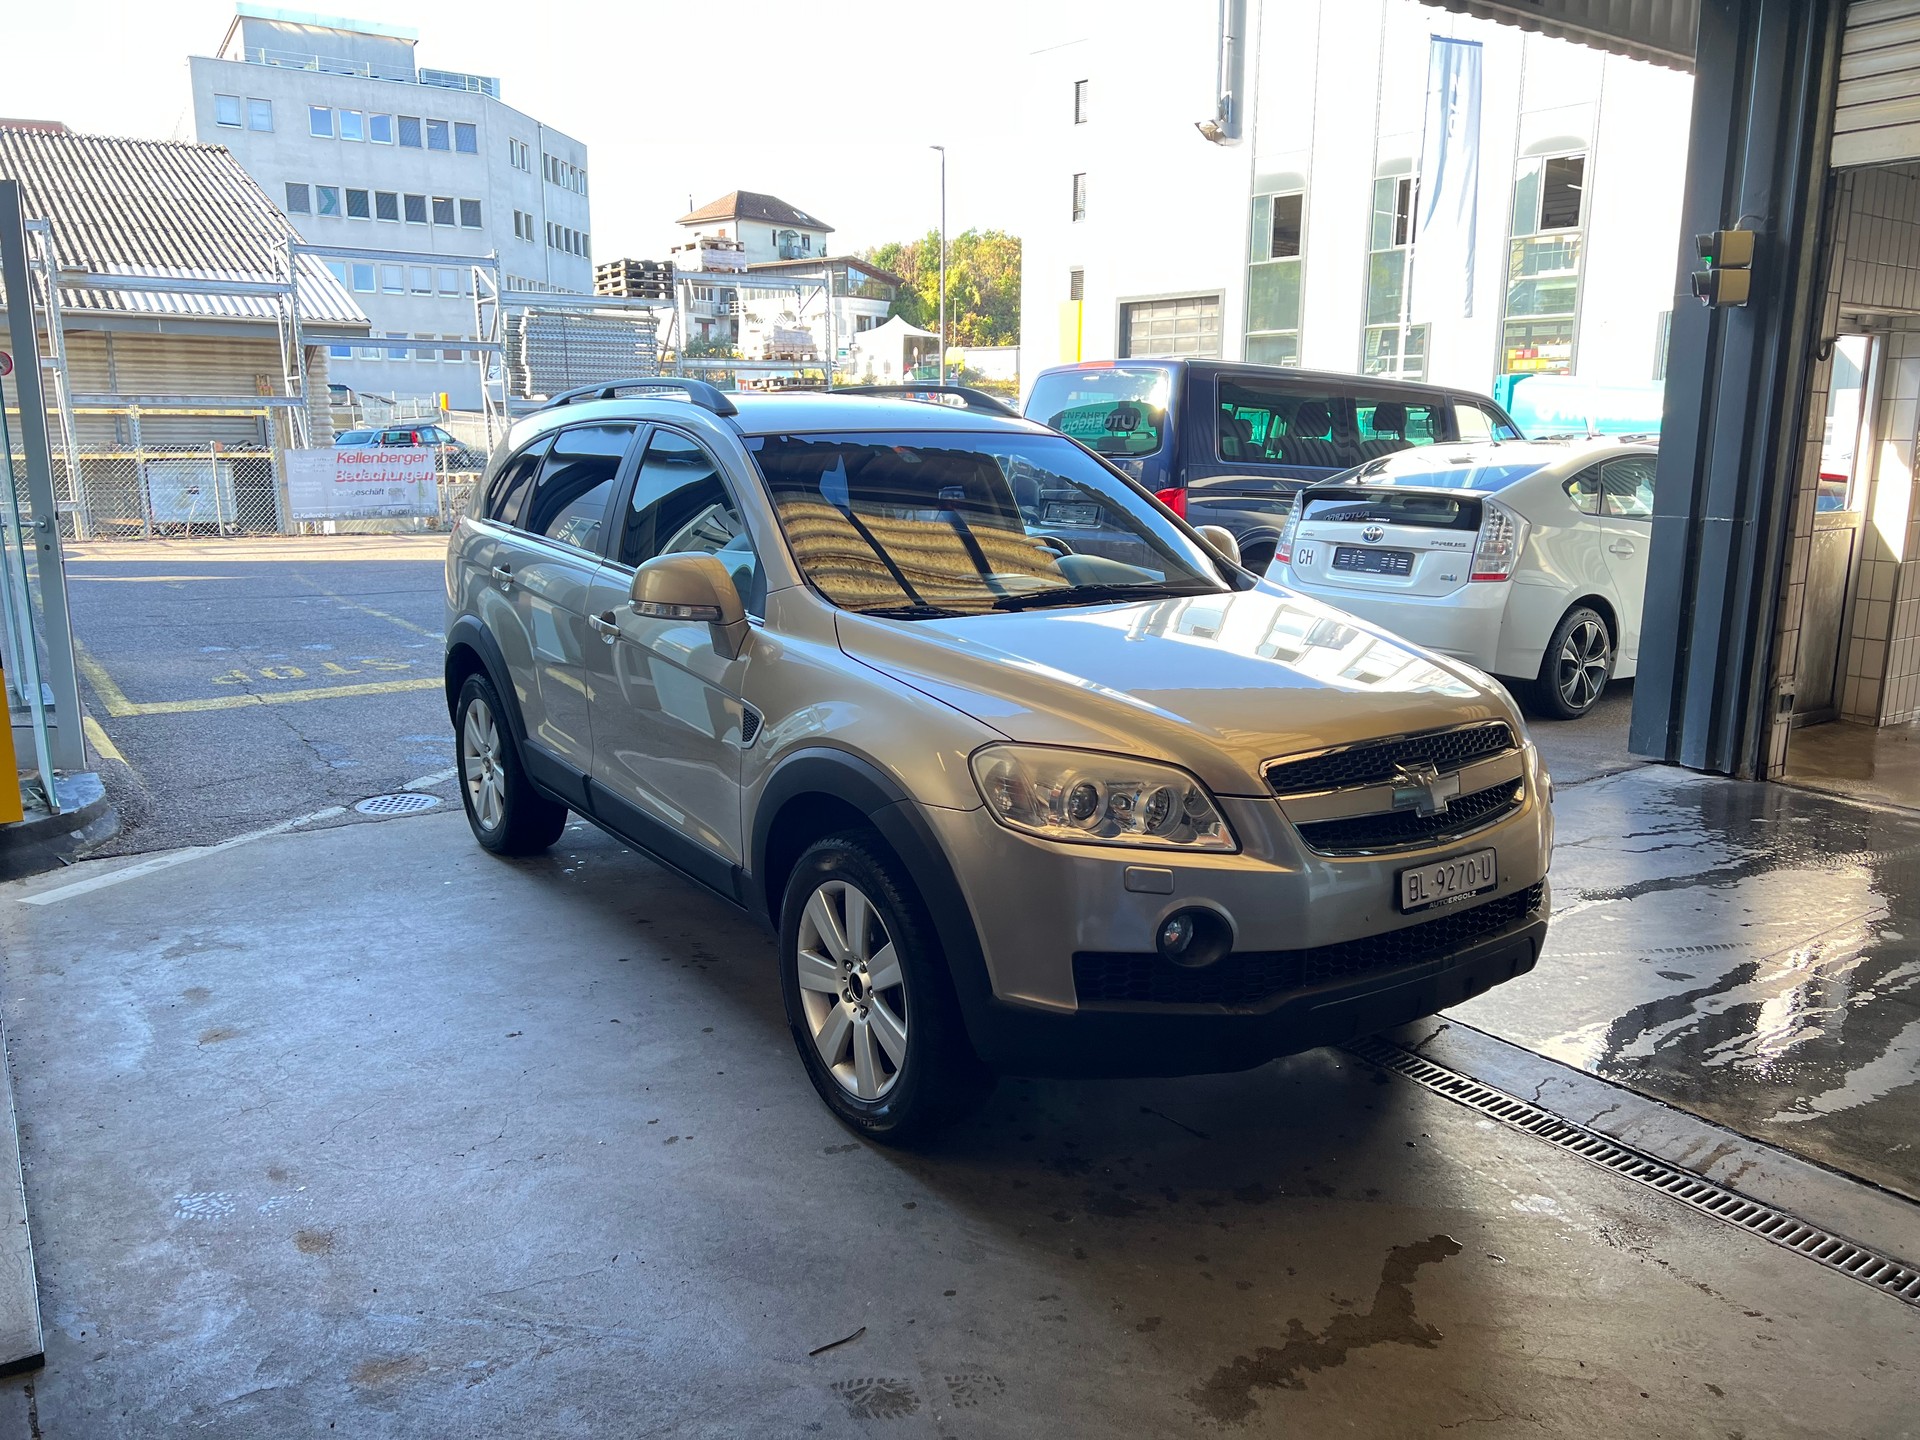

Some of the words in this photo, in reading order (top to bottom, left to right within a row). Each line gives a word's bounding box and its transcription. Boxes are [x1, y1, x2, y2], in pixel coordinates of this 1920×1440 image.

[336, 451, 428, 465] Kellenberger
[1298, 548, 1314, 565] CH
[1428, 890, 1477, 908] AUTOERGOLZ
